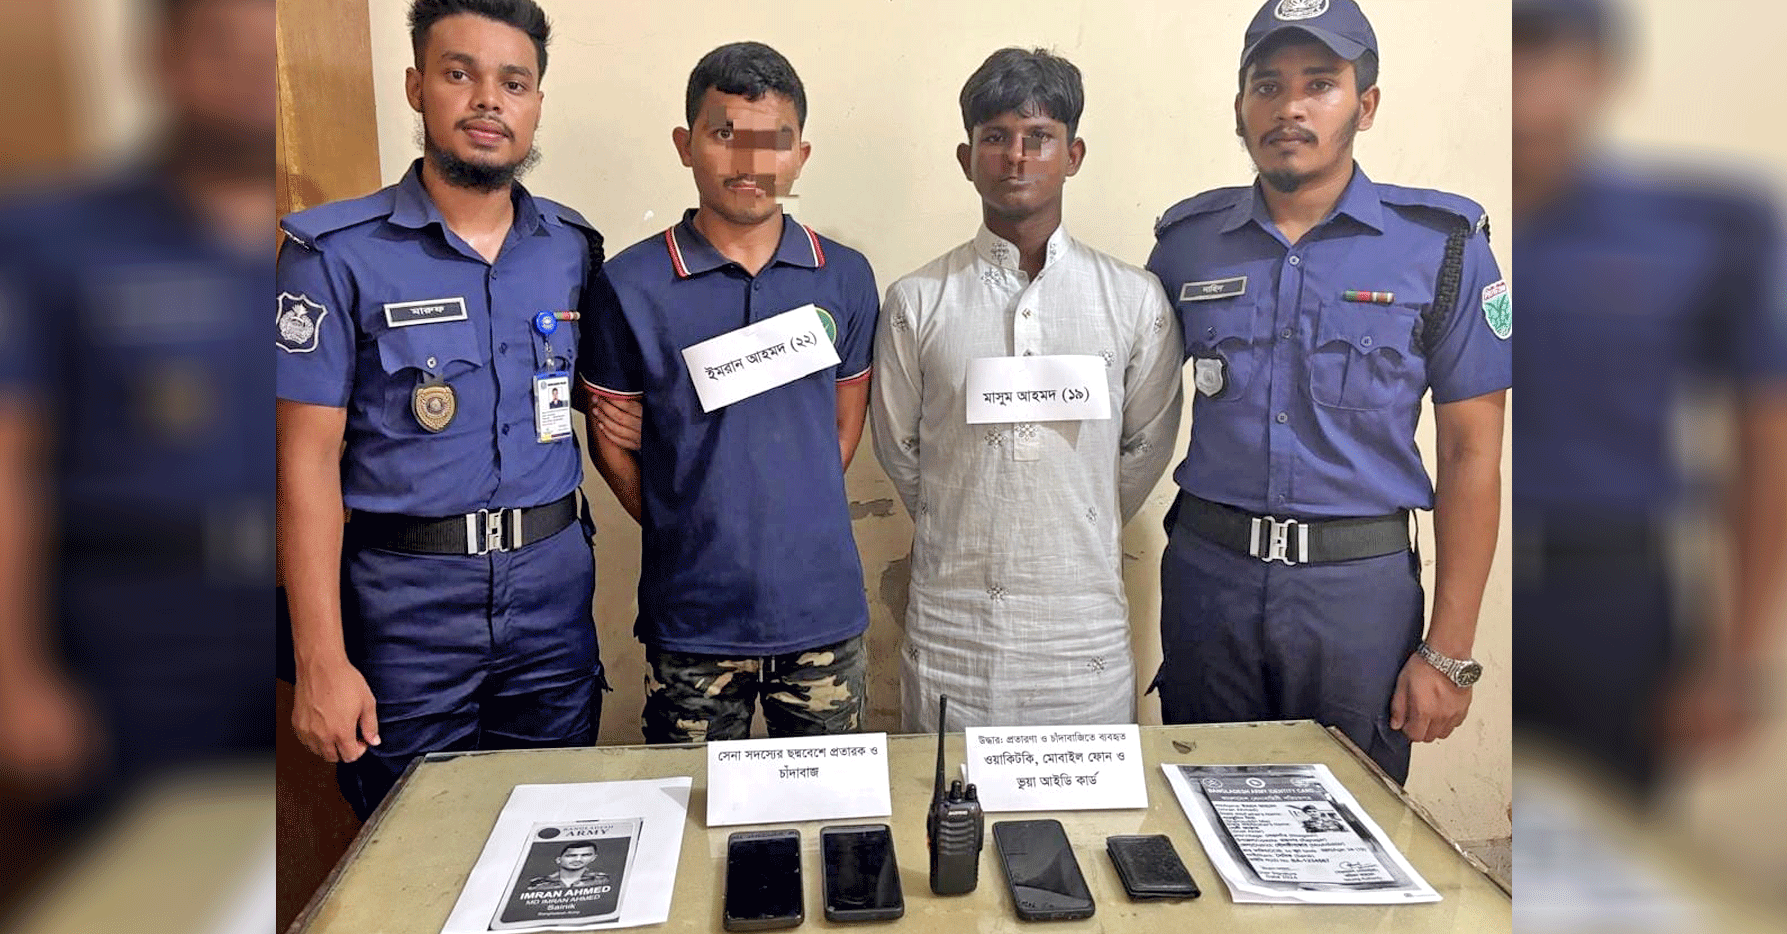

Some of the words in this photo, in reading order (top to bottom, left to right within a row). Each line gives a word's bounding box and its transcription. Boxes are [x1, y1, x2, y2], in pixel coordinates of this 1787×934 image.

[704, 358, 745, 380] ইমরান
[745, 342, 786, 364] আহমদ
[790, 330, 818, 352] (২২)
[982, 391, 1012, 406] মাসুম
[1017, 390, 1057, 402] আহমদ
[1062, 386, 1090, 403] (১৯)
[1006, 734, 1037, 744] প্রতারণা
[1050, 731, 1096, 743] চাঁদাবাজিতে
[1098, 732, 1126, 742] ব্যবহৃত
[718, 751, 741, 761] সেনা
[745, 750, 783, 760] সদস্যের
[786, 748, 826, 760] ছদ্মবেশে
[830, 746, 866, 758] প্রতারক
[869, 746, 878, 756] ও
[984, 750, 1038, 766] ওয়াকিটকি,
[1042, 750, 1084, 764] মোবাইল
[1088, 751, 1112, 763] ফোন
[1116, 752, 1125, 761] ও
[778, 765, 819, 778] চাঁদাবাজ
[1016, 776, 1036, 790] ভুয়া
[1040, 773, 1072, 787] আইডি
[1075, 770, 1100, 786] কার্ড
[565, 829, 610, 838] ARMY
[520, 890, 562, 900] IMRAN
[564, 885, 612, 897] AHMED
[570, 894, 601, 902] AHMED
